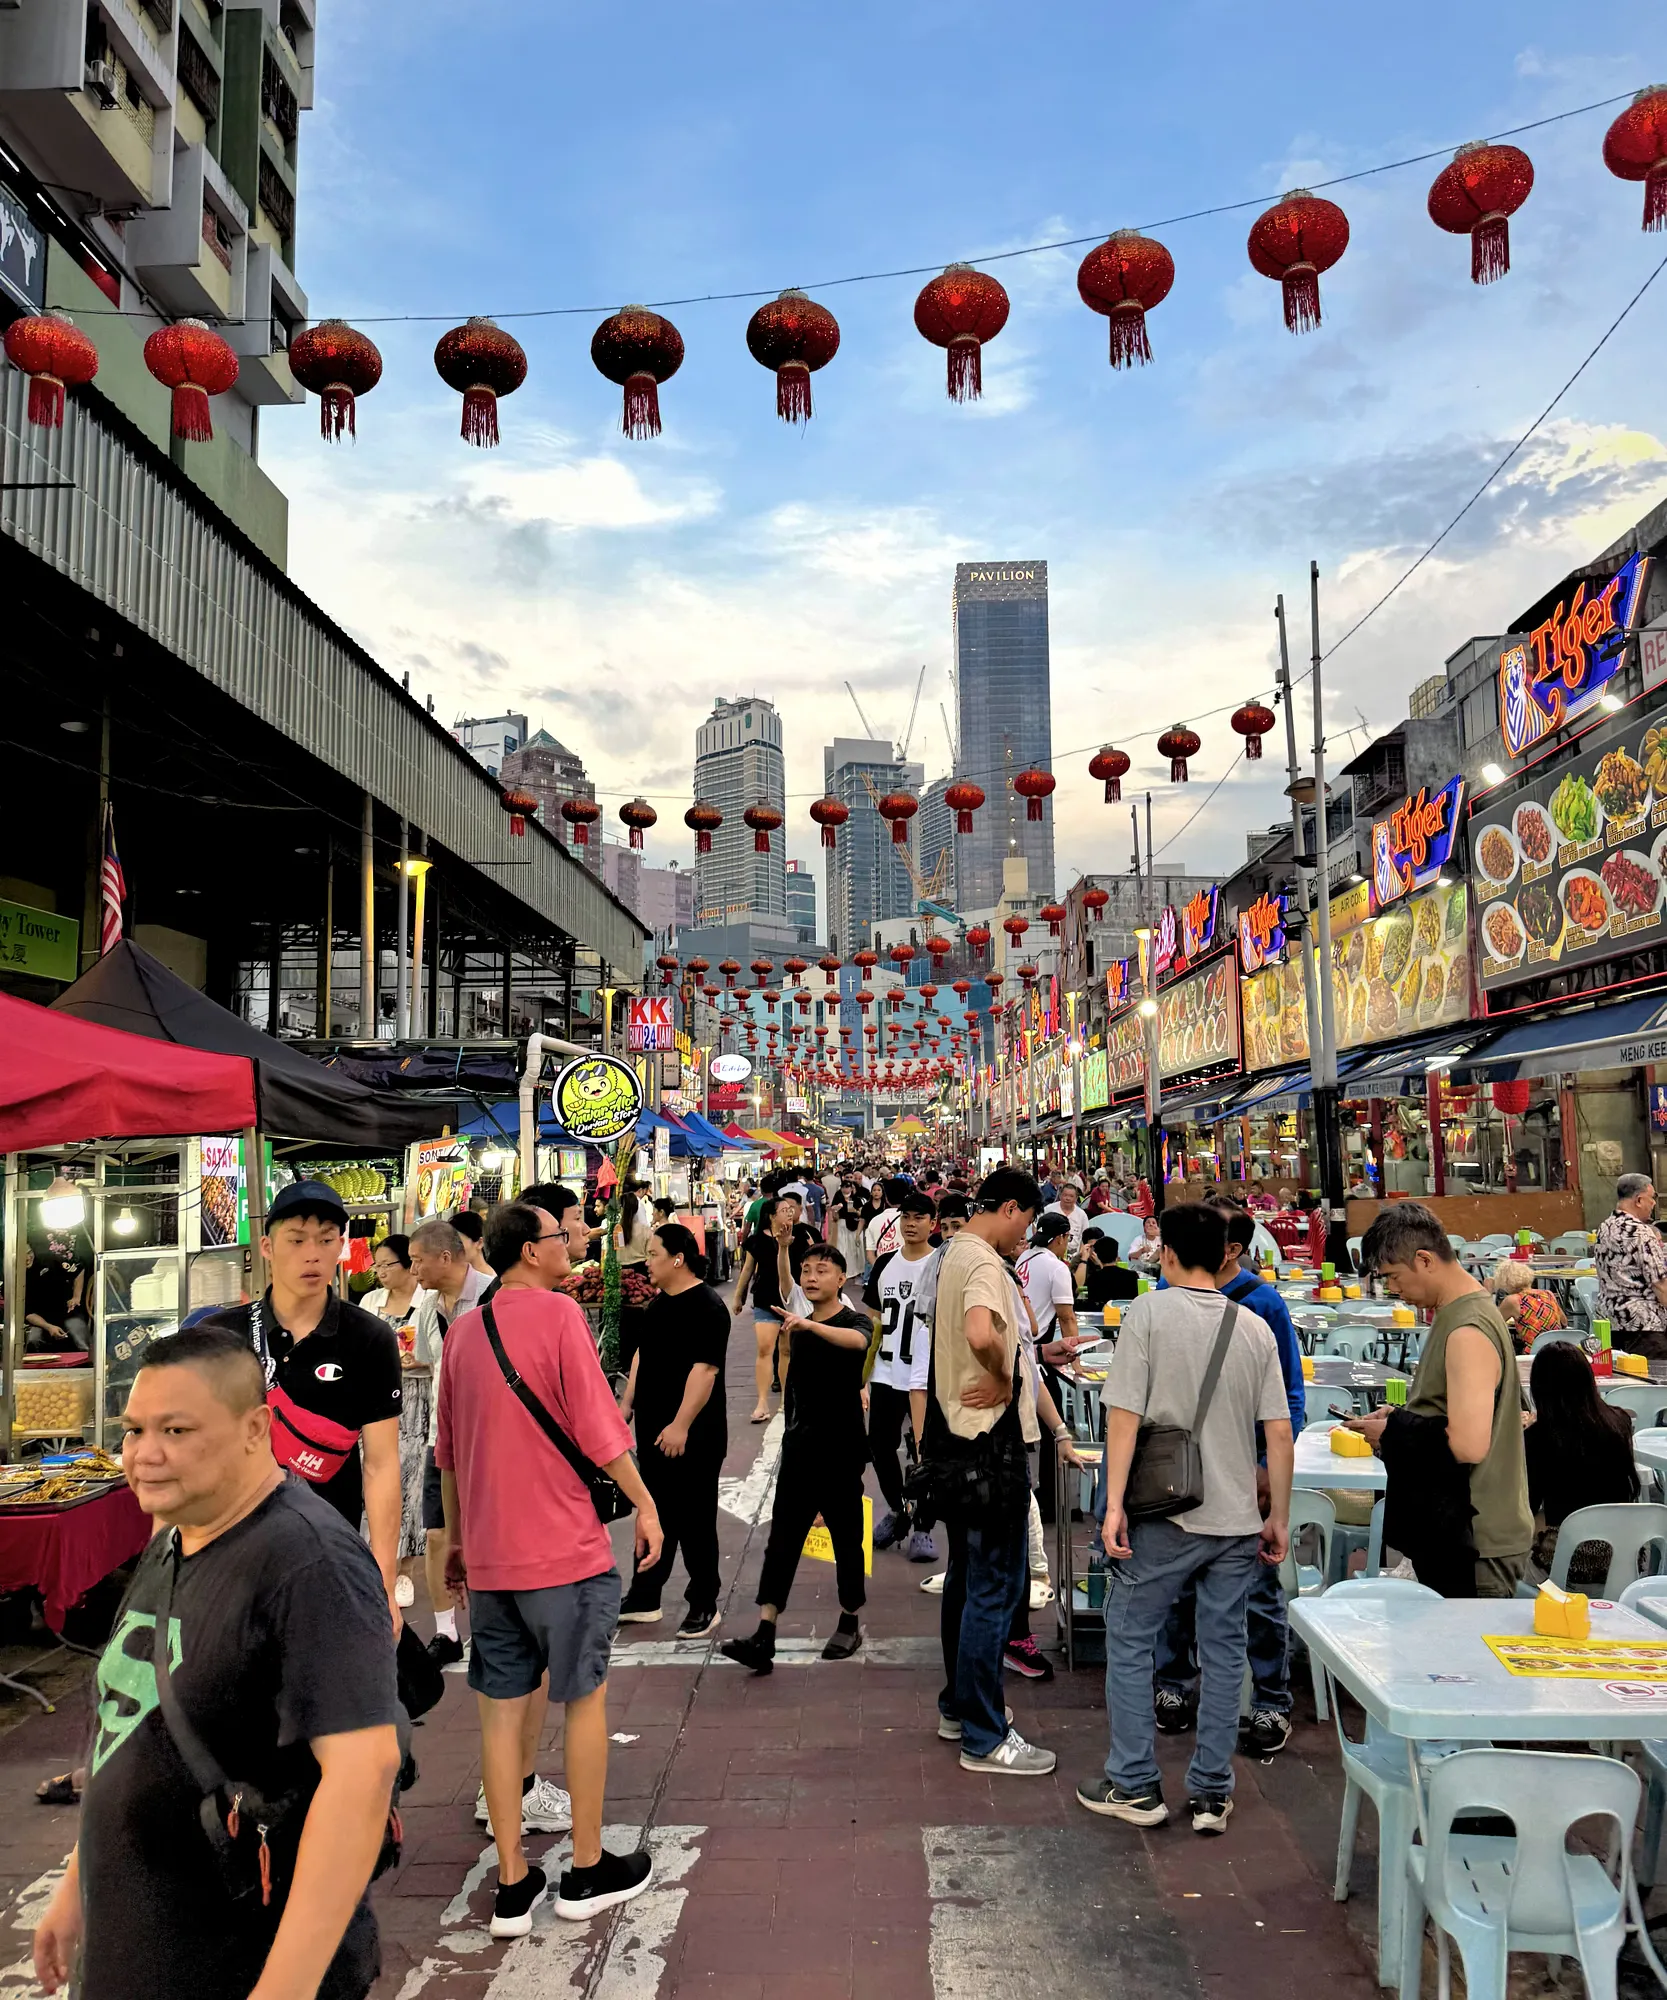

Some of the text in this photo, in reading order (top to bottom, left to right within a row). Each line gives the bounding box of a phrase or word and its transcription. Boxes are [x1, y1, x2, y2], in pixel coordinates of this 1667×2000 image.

[970, 570, 1034, 582] PAVILION
[1530, 577, 1620, 689] Tiger
[1644, 631, 1667, 676] RE
[1391, 785, 1447, 866] Tiger
[16, 912, 60, 942] Tower
[1248, 891, 1281, 949] Tiger
[631, 998, 668, 1025] KK
[643, 1025, 656, 1049] 24
[657, 1025, 671, 1048] JAM
[1620, 1041, 1667, 1062] MENG KEE
[564, 1106, 609, 1129] Anwar
[610, 1095, 639, 1112] Alor
[576, 1118, 609, 1135] Durian
[612, 1108, 639, 1122] Store
[206, 1146, 233, 1168] SATAY
[884, 1286, 896, 1296] EST
[297, 1450, 325, 1471] HH
